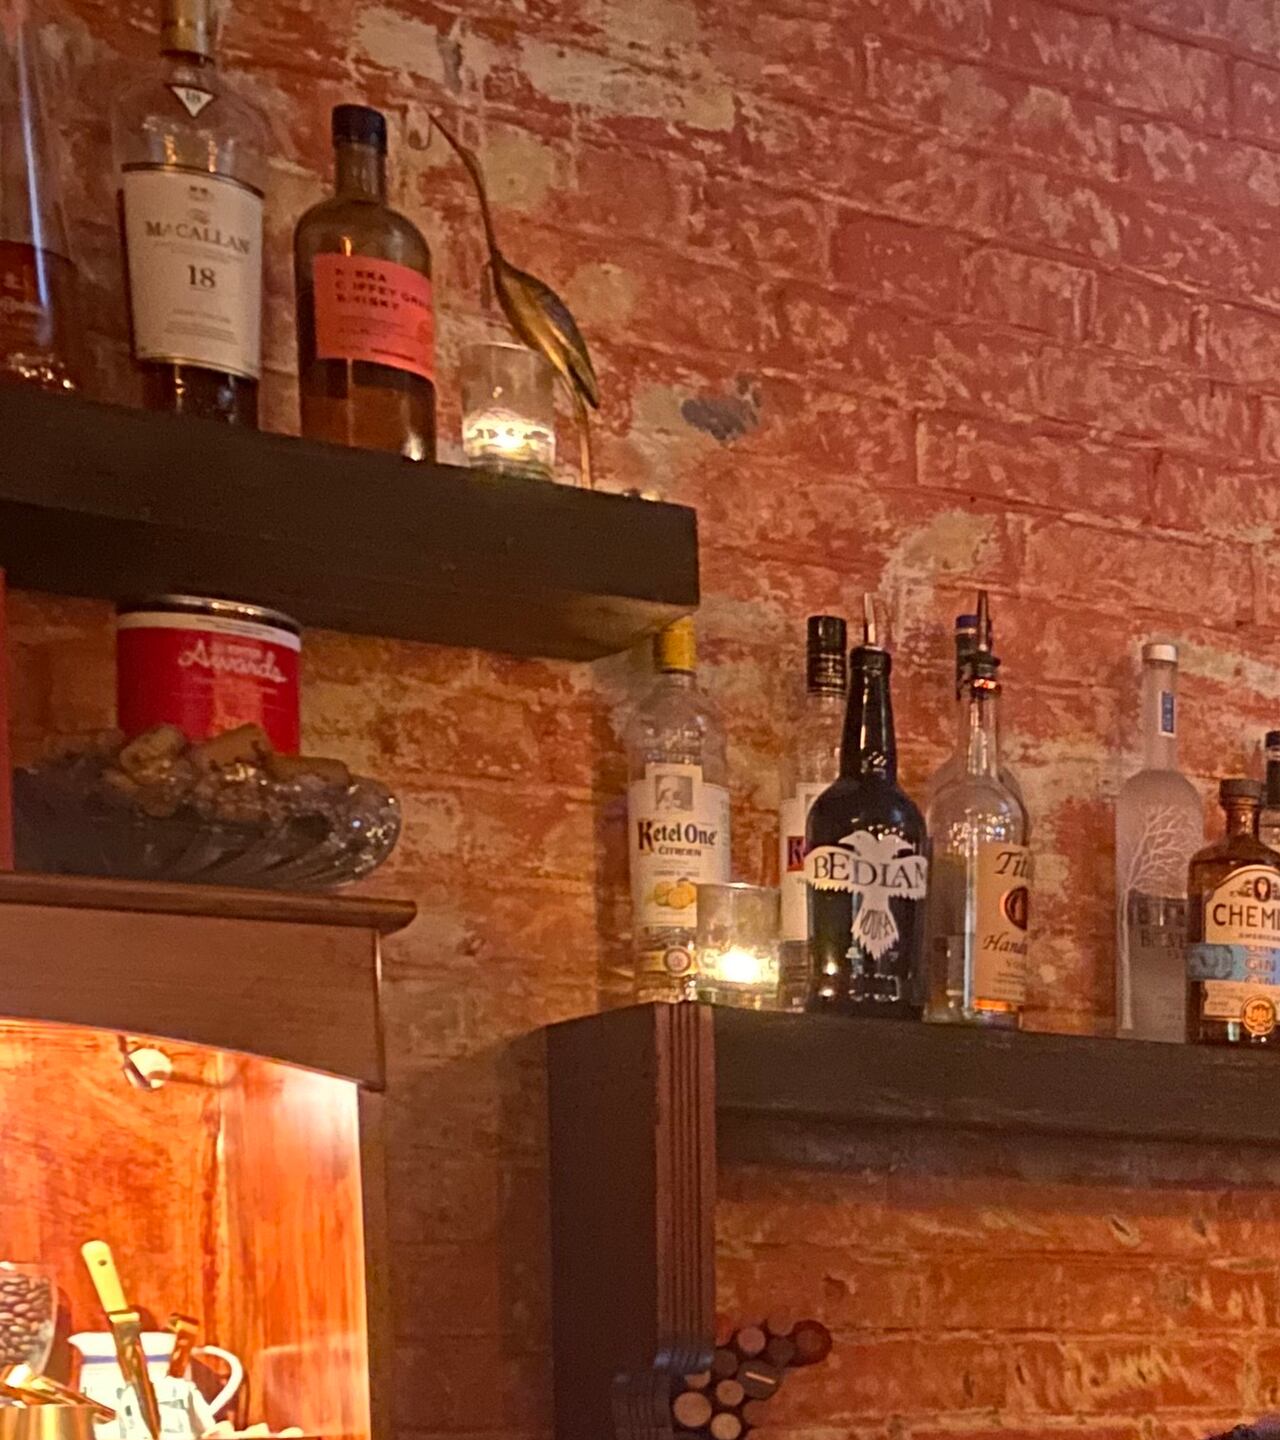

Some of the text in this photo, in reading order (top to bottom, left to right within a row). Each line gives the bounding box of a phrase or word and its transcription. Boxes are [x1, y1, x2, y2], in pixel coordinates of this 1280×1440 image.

[187, 264, 217, 289] 18
[176, 638, 288, 684] Awards
[637, 820, 718, 852] Ketel One
[1244, 958, 1277, 973] GIN
